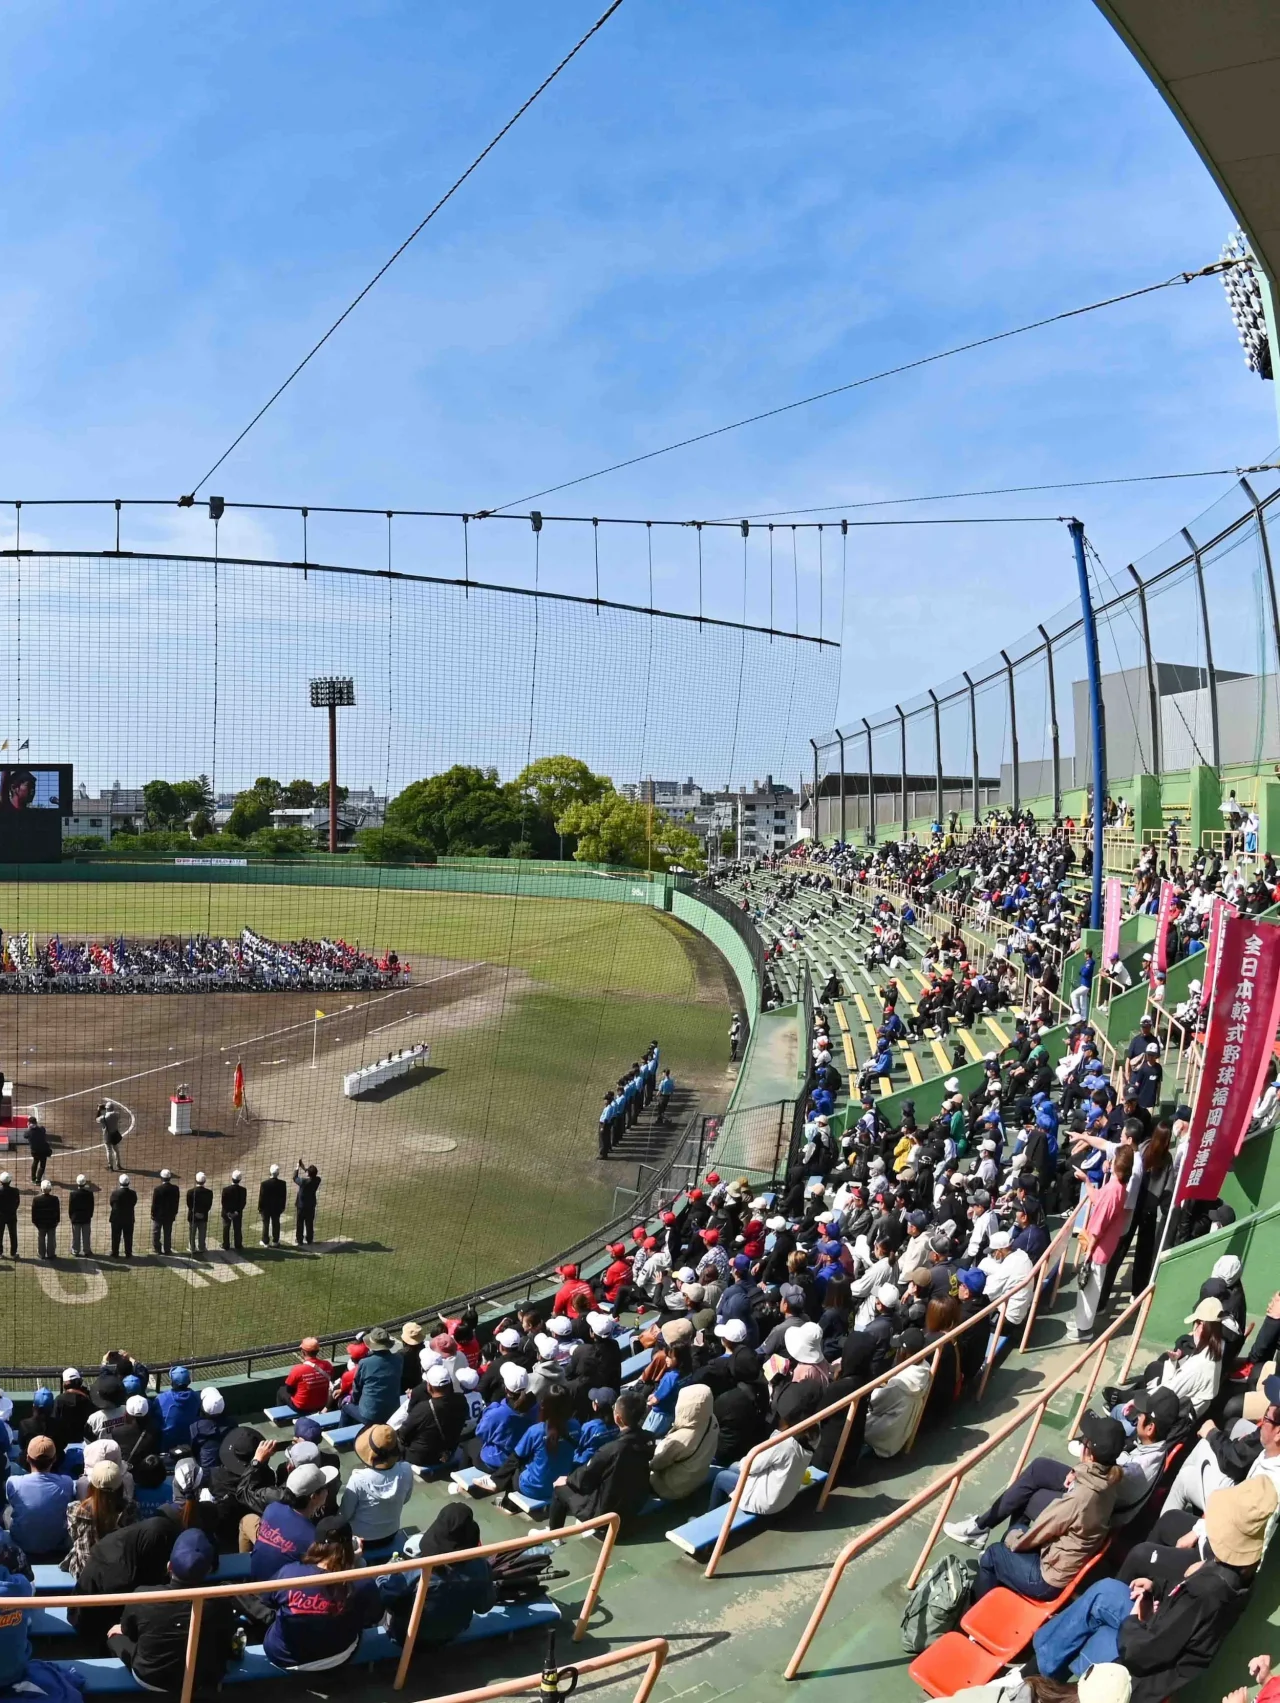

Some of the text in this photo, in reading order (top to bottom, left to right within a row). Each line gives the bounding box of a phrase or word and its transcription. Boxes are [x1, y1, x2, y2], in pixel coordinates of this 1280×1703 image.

[1185, 933, 1264, 1188] 全日本軟式野球福岡県連盟
